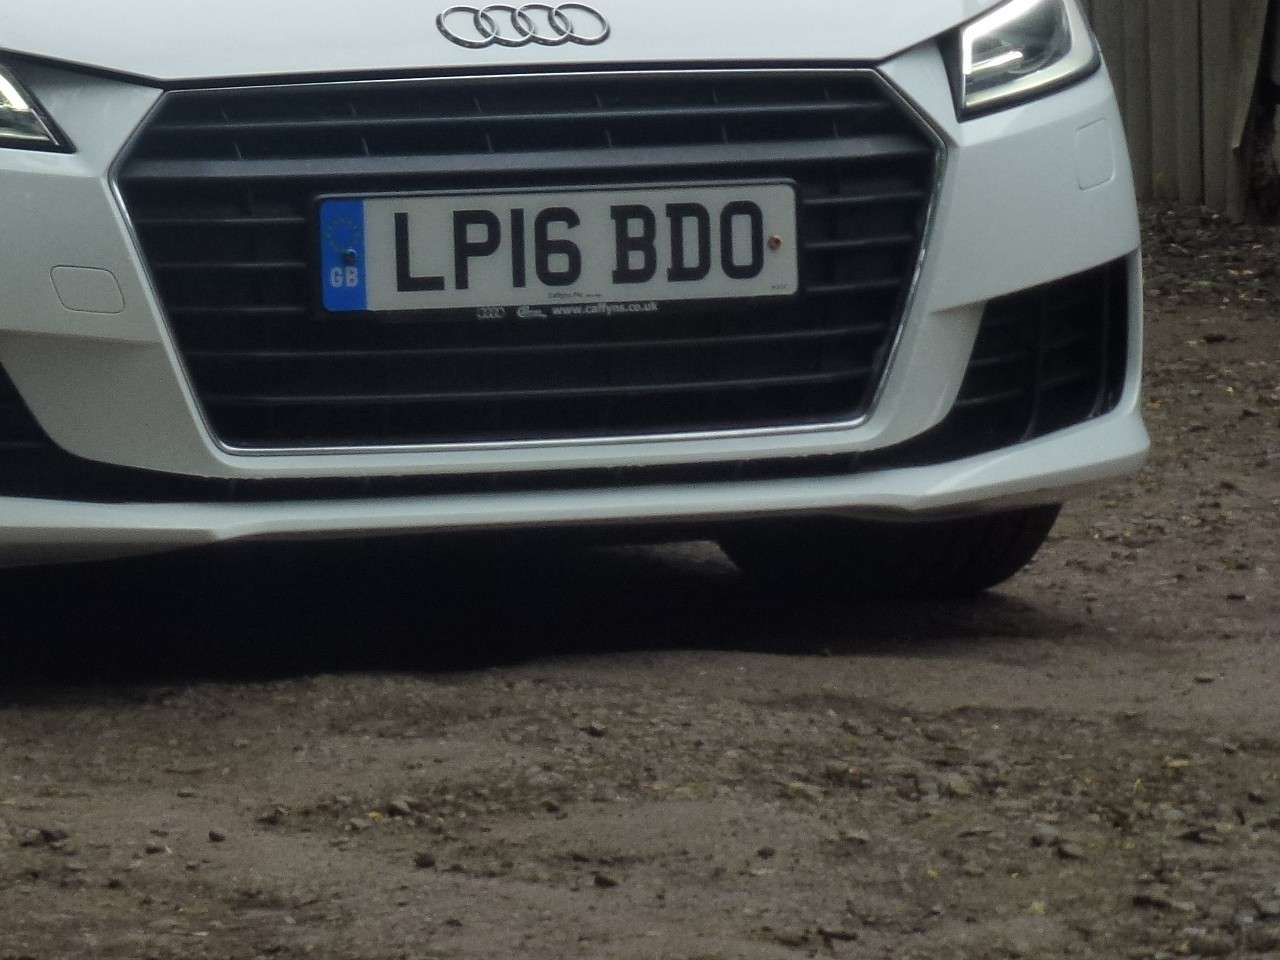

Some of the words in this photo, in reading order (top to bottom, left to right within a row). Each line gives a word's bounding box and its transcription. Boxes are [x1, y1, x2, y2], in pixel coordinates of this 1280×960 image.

[393, 206, 582, 292] LP16
[609, 200, 765, 285] BDO
[328, 266, 360, 289] GB
